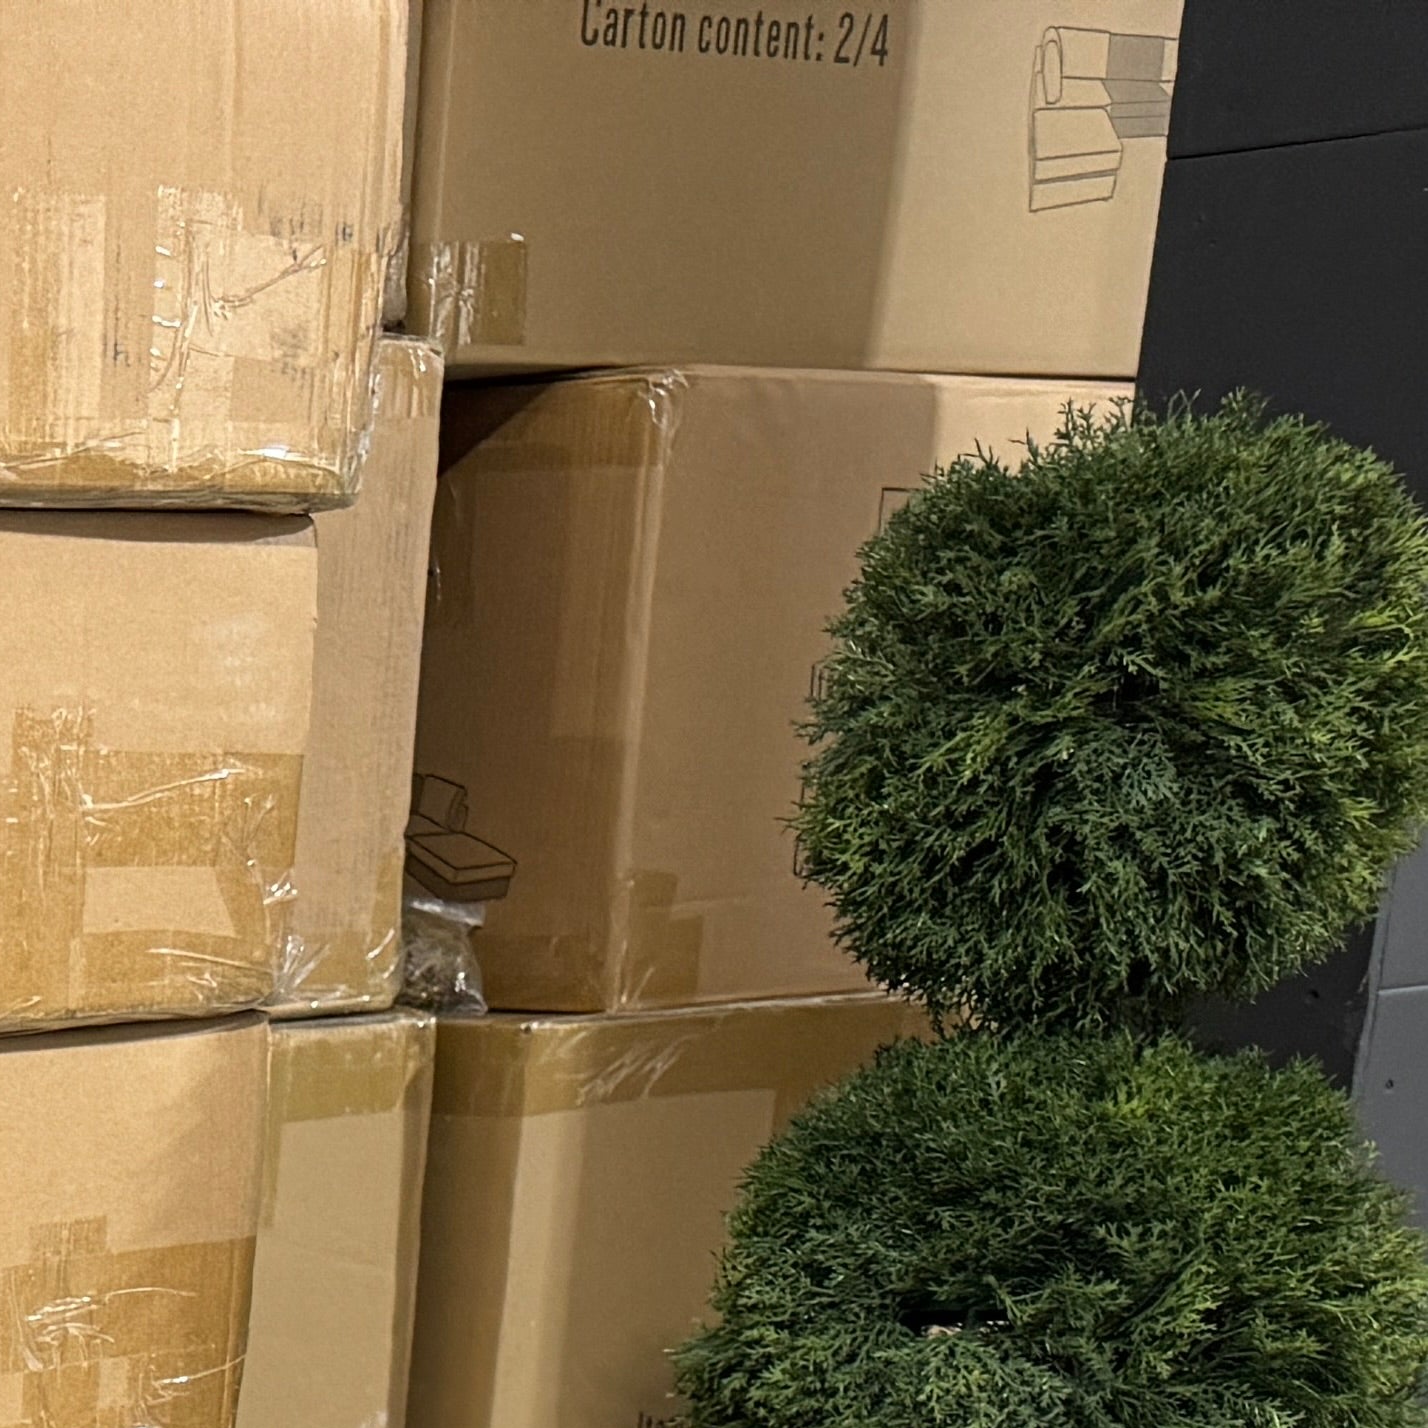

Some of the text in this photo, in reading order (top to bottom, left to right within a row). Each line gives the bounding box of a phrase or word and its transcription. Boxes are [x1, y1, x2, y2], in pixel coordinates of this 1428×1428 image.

[581, 0, 890, 67] Carton content: 2/4
